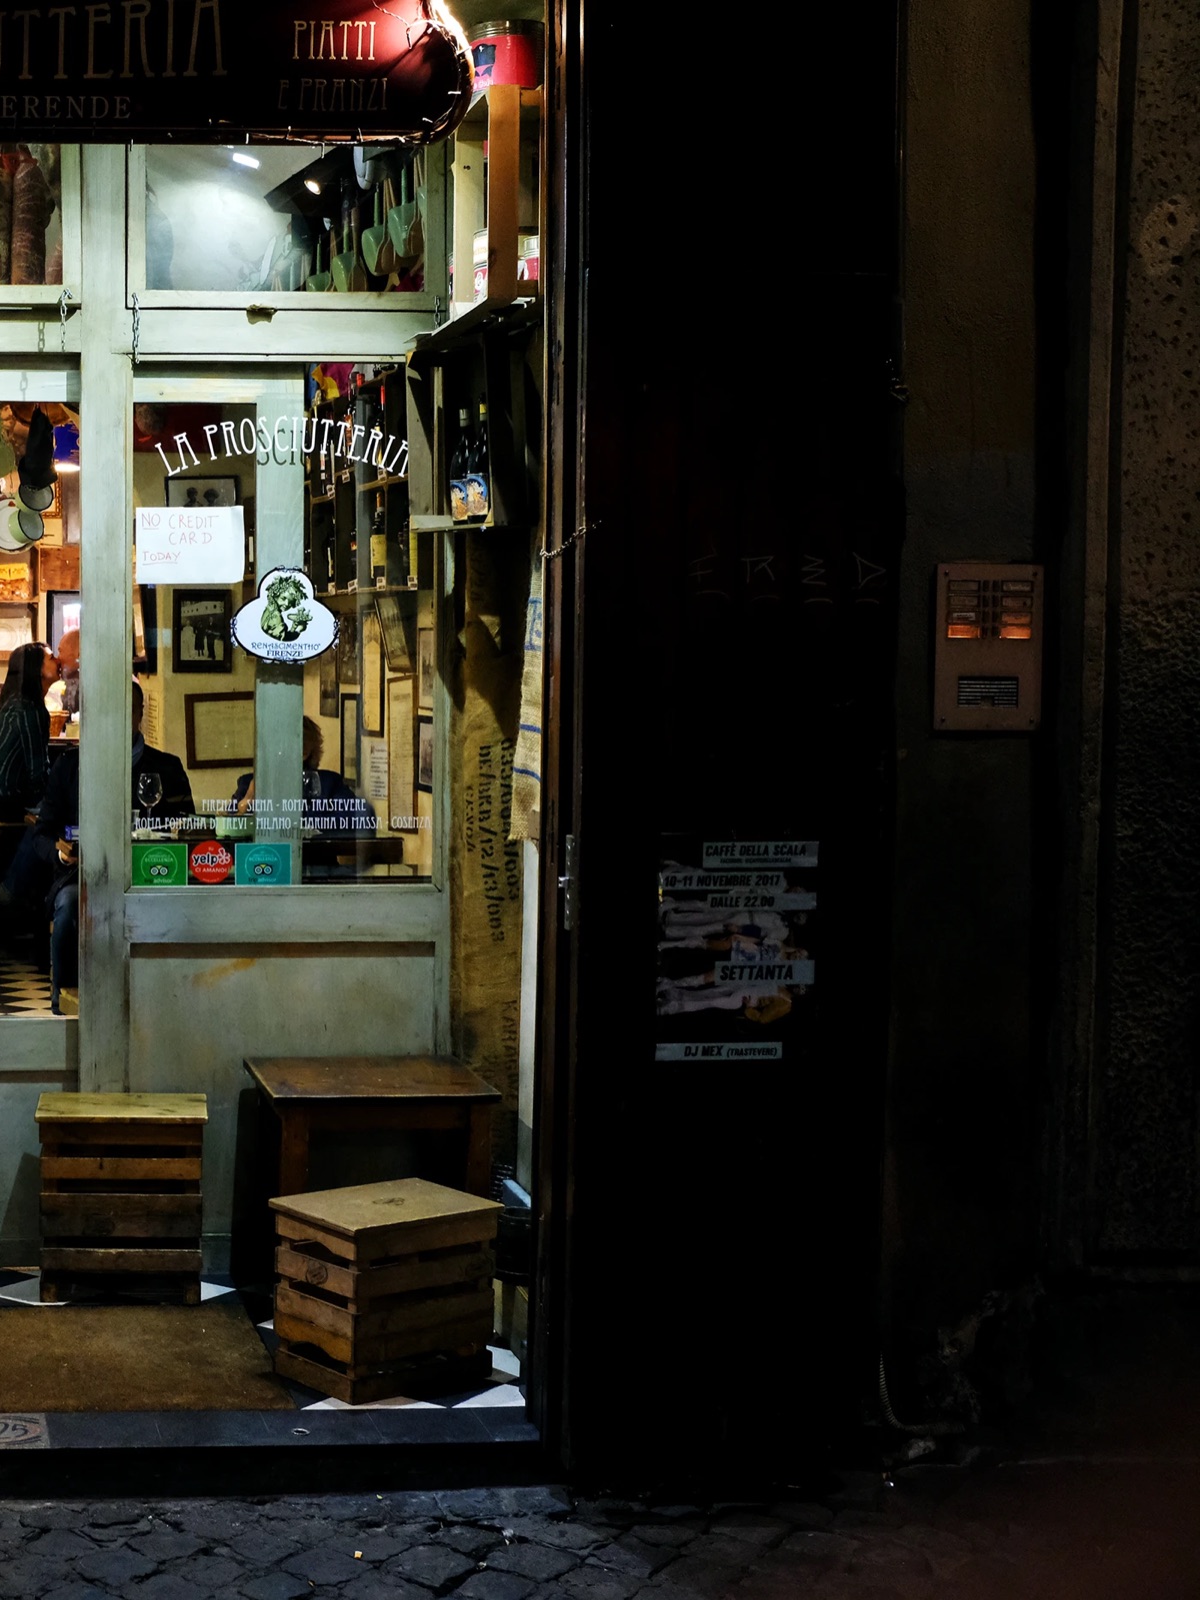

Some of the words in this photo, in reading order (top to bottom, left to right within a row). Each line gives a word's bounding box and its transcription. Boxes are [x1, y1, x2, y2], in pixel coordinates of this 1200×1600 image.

[293, 20, 376, 60] PIATTI
[277, 79, 289, 110] E
[299, 78, 390, 112] PRANZI
[155, 432, 200, 476] LA
[203, 415, 410, 478] PROSCIUTTERIA
[141, 513, 161, 528] NO
[168, 513, 220, 529] CREDIT
[168, 532, 213, 546] CARD
[142, 551, 181, 562] TODAY
[266, 649, 304, 658] FIRENZE
[202, 799, 238, 812] FIRENZE
[247, 799, 273, 811] SIENA
[282, 799, 308, 811] ROMA
[311, 799, 367, 811] TRASTEVERE
[135, 817, 160, 830] ROMA
[164, 817, 206, 830] FONTANA
[209, 817, 218, 830] DI
[221, 817, 247, 830] TREVI
[256, 817, 291, 830] MILANO
[300, 816, 337, 829] MARINA
[340, 816, 349, 829] DI
[351, 816, 382, 829] MASSA
[391, 816, 432, 829] COSENZA
[705, 843, 736, 856] CAFFÈ
[740, 844, 768, 856] DELLA
[773, 844, 806, 856] SCALA
[192, 852, 218, 867] yelp
[665, 875, 693, 887] 10-11
[697, 875, 751, 887] NOVEMBRE
[755, 875, 781, 886] 2017
[710, 896, 740, 907] DALLE
[744, 896, 775, 907] 22.00
[720, 965, 793, 981] SETTANTA
[684, 1046, 698, 1057] DJ
[702, 1045, 723, 1057] MEX
[727, 1046, 777, 1058] (TRASTEVERE)
